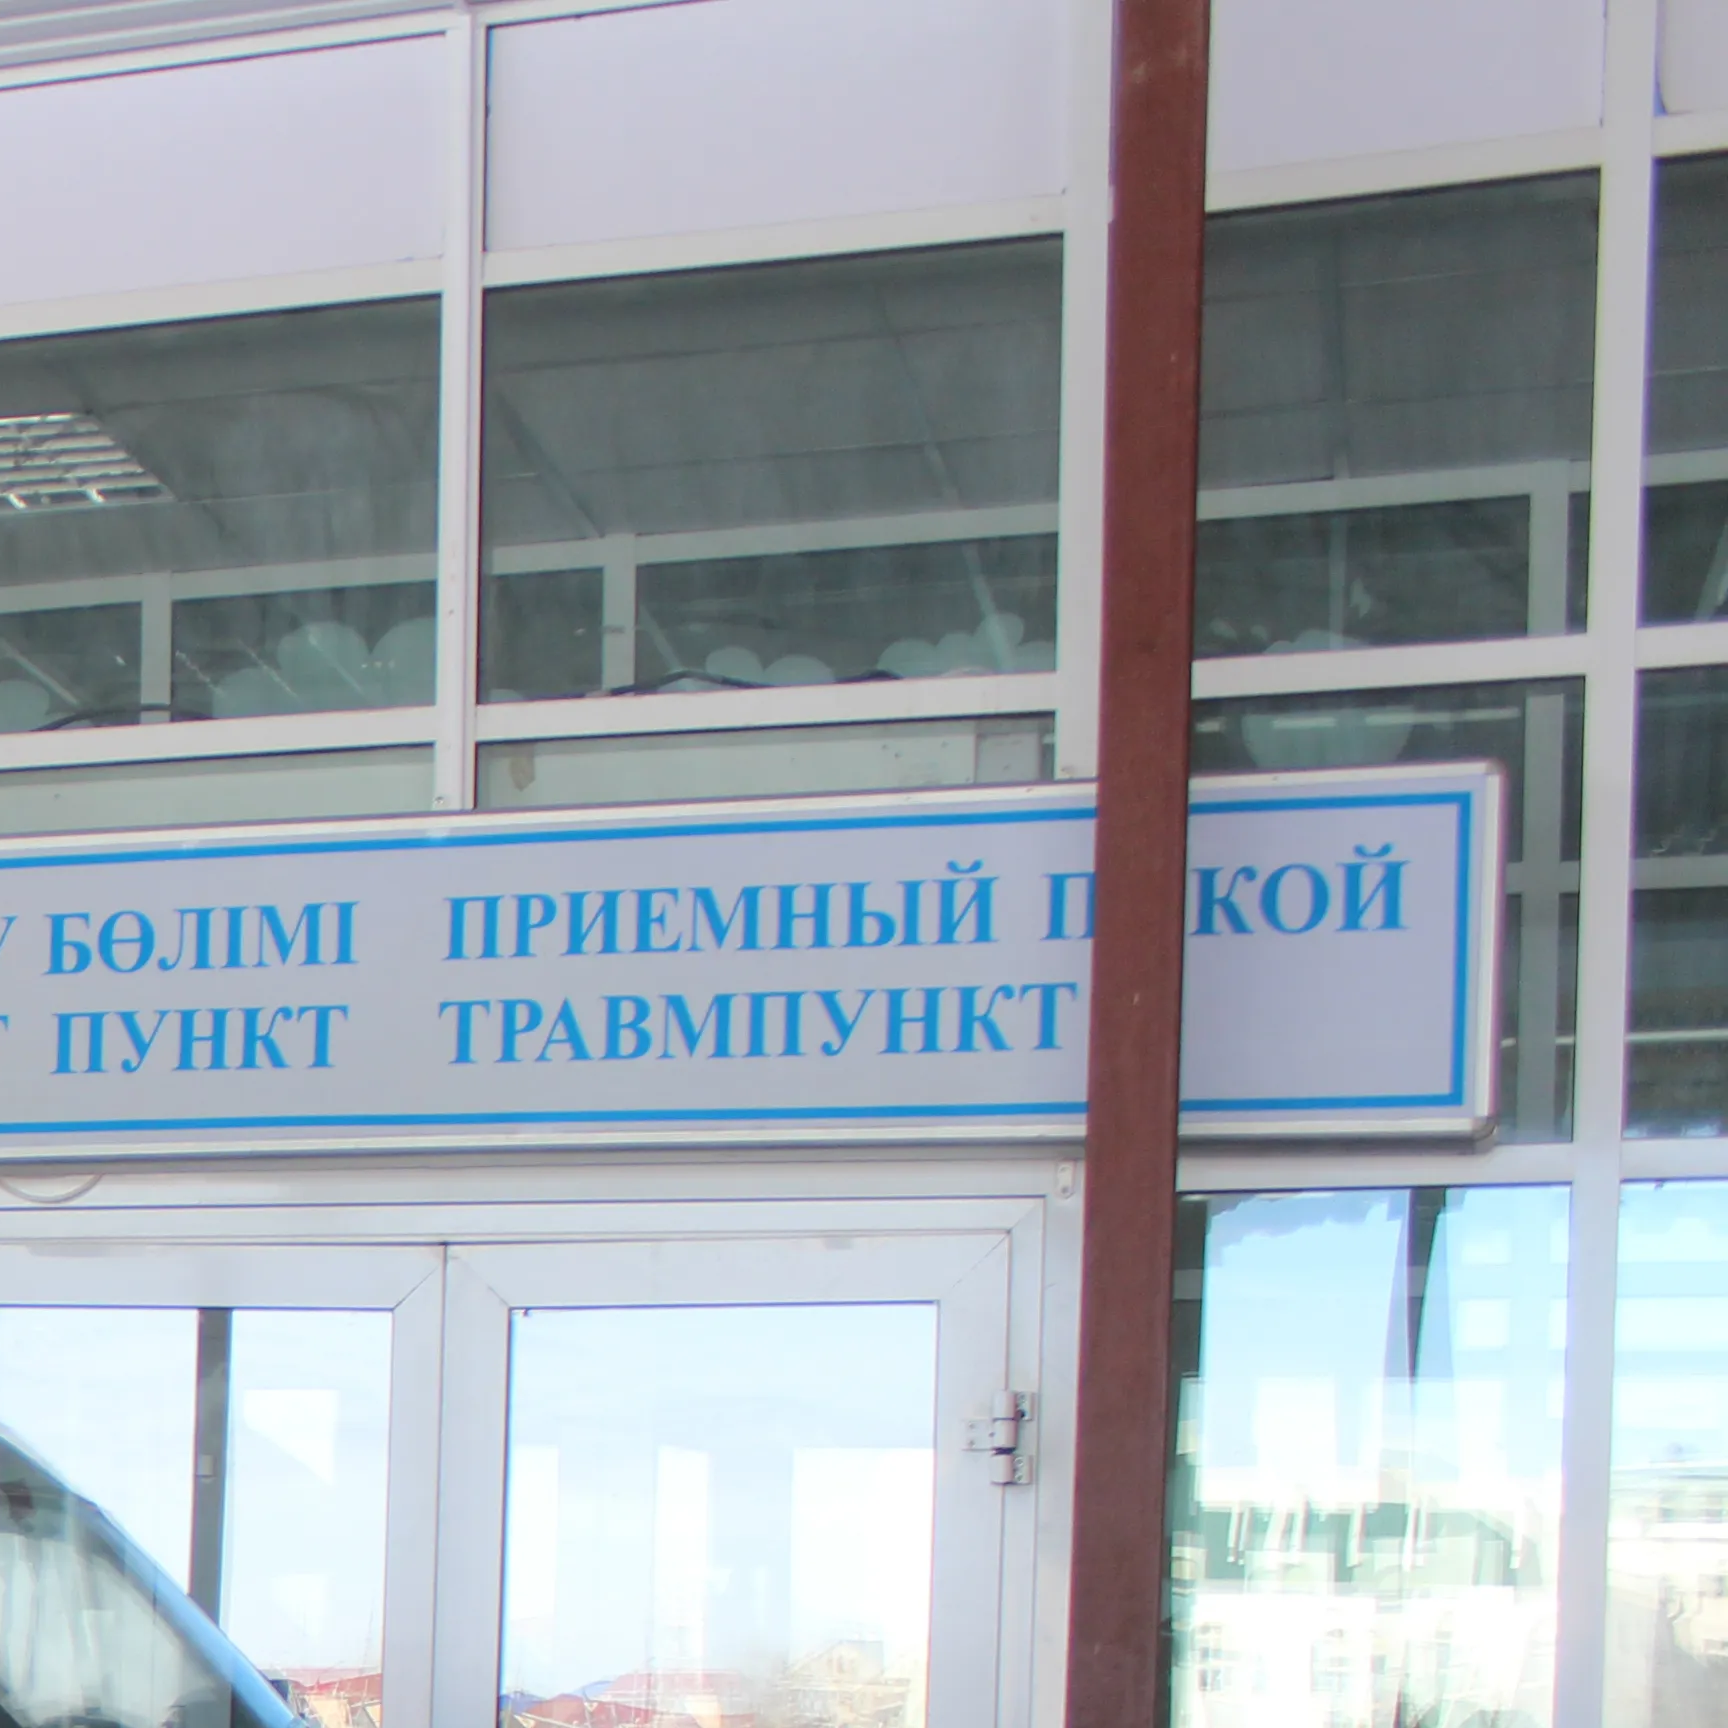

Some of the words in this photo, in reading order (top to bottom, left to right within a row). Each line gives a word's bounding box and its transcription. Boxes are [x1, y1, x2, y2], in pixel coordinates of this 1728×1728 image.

[44, 900, 360, 977] БӨЛІМІ
[442, 858, 1000, 962] ПРИЕМНЫЙ
[1039, 841, 1411, 942] ПКОЙ
[50, 1003, 350, 1076] ПУНКТ
[438, 981, 1080, 1066] ТРАВМПУНКТ
